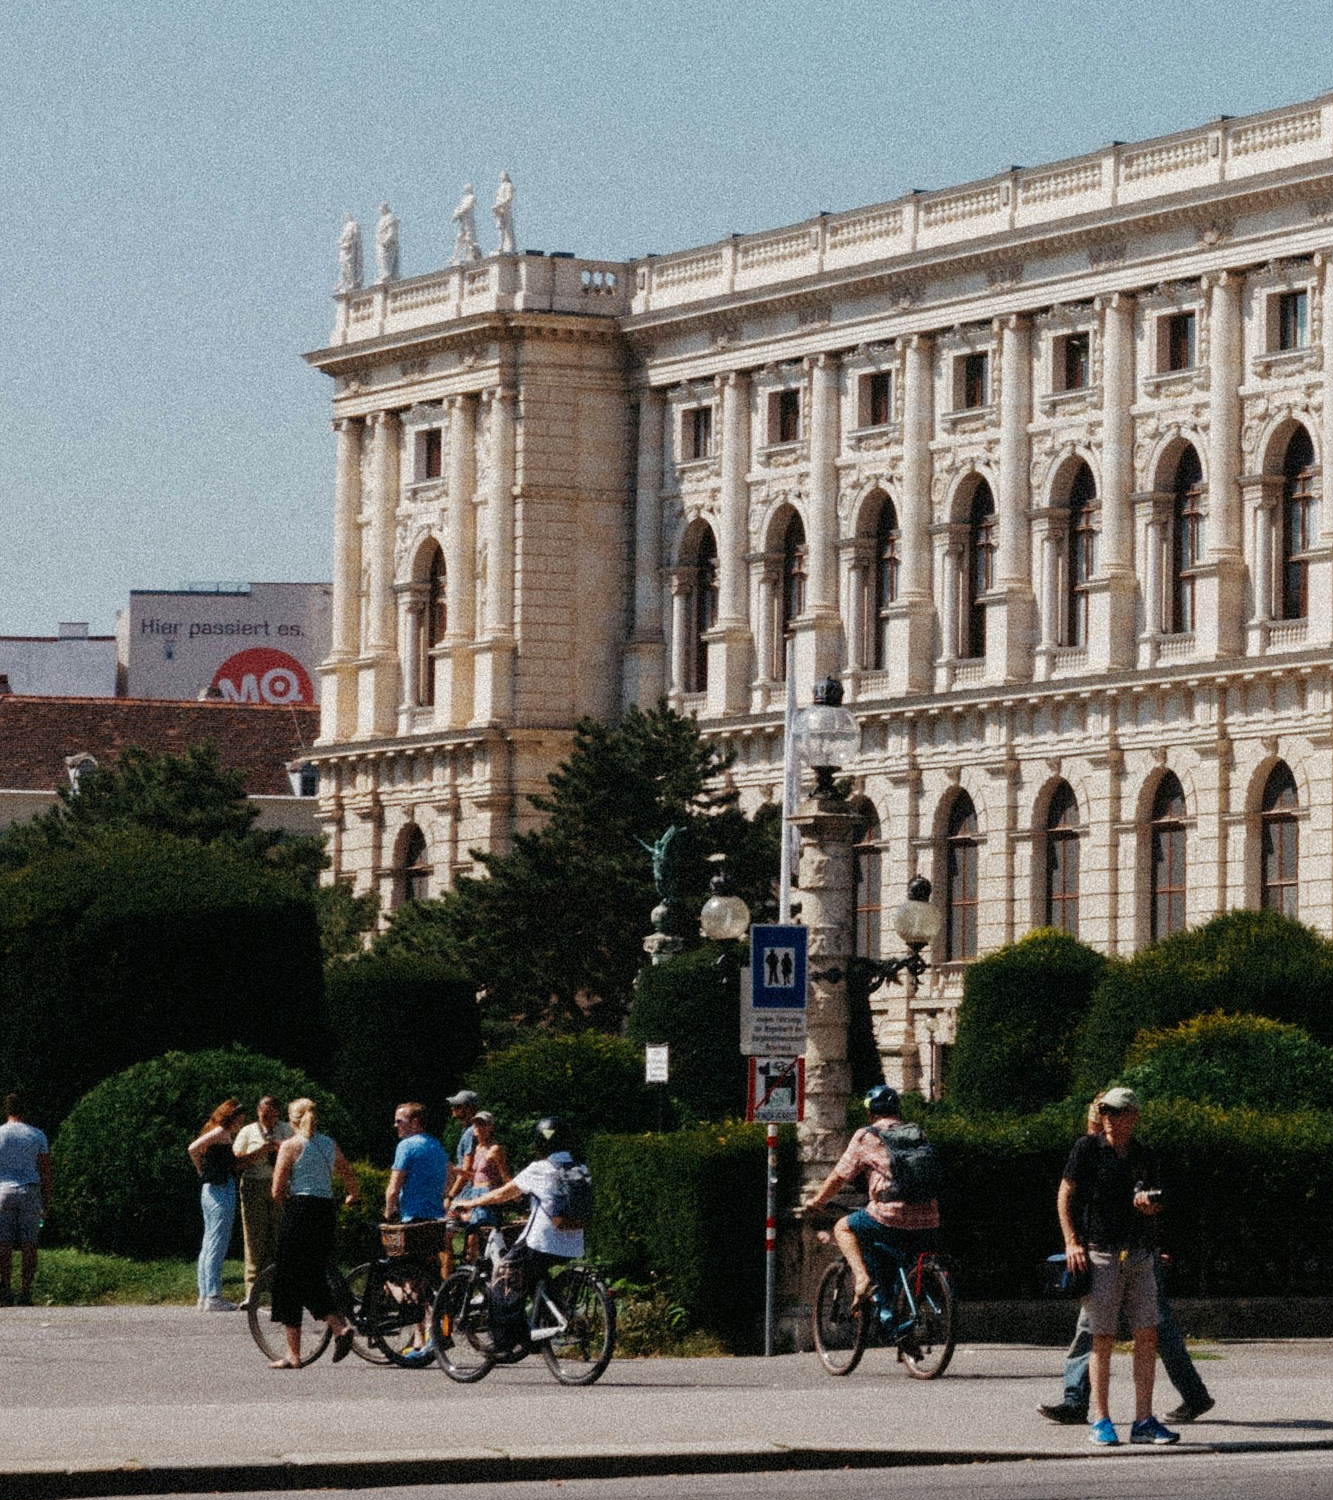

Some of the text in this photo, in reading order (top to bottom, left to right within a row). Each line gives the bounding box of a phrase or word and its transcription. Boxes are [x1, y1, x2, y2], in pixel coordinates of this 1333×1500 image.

[141, 618, 305, 639] Hier passiert es.
[219, 667, 303, 703] MQ
